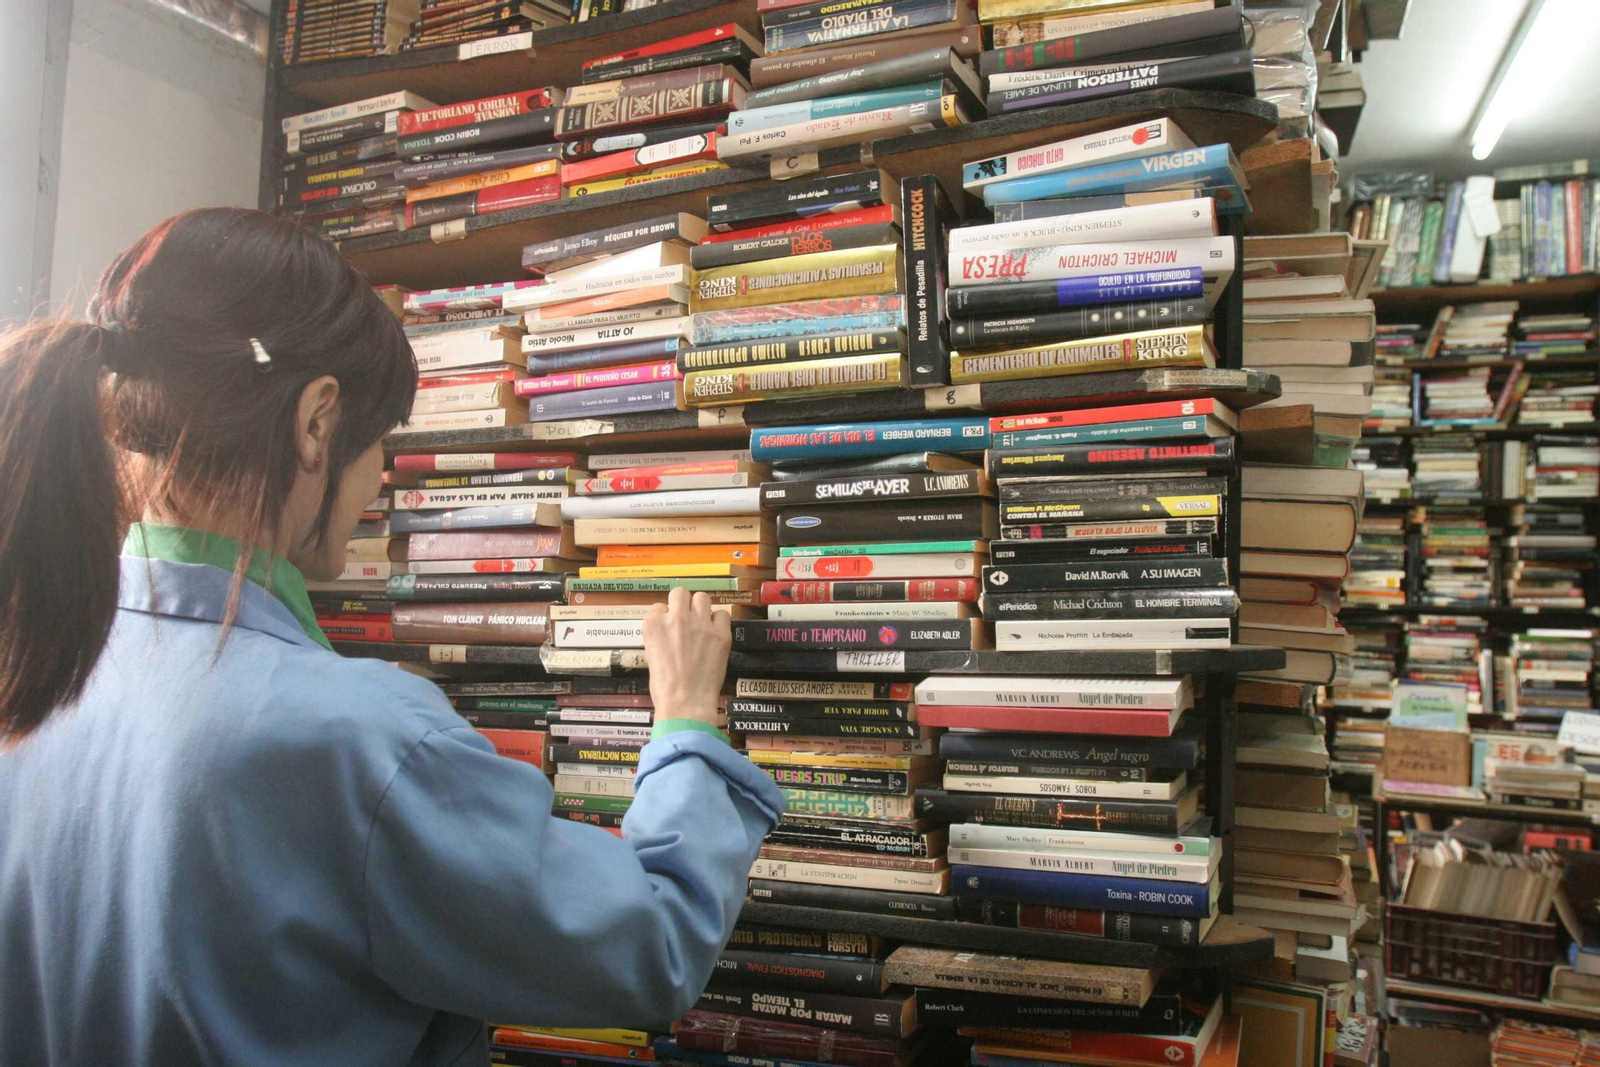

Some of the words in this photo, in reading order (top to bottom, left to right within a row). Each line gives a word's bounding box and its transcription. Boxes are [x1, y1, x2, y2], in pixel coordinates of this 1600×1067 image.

[821, 10, 869, 30] DIABLO
[871, 6, 893, 21] DEL
[892, 14, 909, 27] LA
[807, 17, 889, 43] ALTERNATIVA
[1077, 65, 1159, 89] PATTERSON
[1131, 76, 1158, 88] JAMES
[1028, 87, 1040, 96] DE
[1041, 80, 1072, 93] LUNA
[1003, 88, 1027, 99] MIEL
[415, 105, 476, 124] VICTORIANO
[478, 96, 520, 113] CORRAL
[434, 133, 455, 143] COOK
[456, 128, 481, 139] ROBIN
[404, 137, 431, 150] TOXINA
[1142, 149, 1208, 174] VIRGEN
[341, 181, 377, 195] CRUCIFAX
[910, 188, 926, 251] HITCHCOCK
[733, 241, 761, 252] ROBERT
[760, 237, 789, 248] CALDER
[800, 231, 824, 242] LOS
[1058, 252, 1119, 270] CRICHTON
[1122, 249, 1178, 267] MICHAEL
[961, 253, 1030, 280] PRESA
[699, 275, 738, 290] KING
[916, 260, 926, 297] Pesadilla
[1098, 274, 1123, 287] OCULTO
[1124, 273, 1134, 284] EN
[1135, 272, 1145, 282] LA
[1146, 268, 1191, 282] PROFUNDIDAD
[699, 284, 737, 300] STEPHEN
[918, 298, 927, 309] de
[623, 327, 634, 337] JO
[918, 310, 928, 342] Relatos
[597, 328, 622, 340] ATTIA
[1135, 332, 1188, 349] STEPHEN
[798, 338, 831, 356] COBEN
[834, 333, 873, 353] HARLAN
[684, 345, 748, 368] OPORTUNIDAD
[751, 342, 787, 360] ÚLTIMA
[1136, 345, 1188, 360] KING
[962, 350, 1038, 374] CEMENTERIO
[1039, 349, 1054, 366] DE
[1055, 343, 1121, 365] ANIMALES
[818, 367, 830, 385] DE
[832, 363, 874, 384] RETRATO
[874, 361, 887, 380] EL
[694, 373, 735, 386] KING
[750, 370, 789, 391] MADDER
[791, 368, 816, 388] ROSE
[694, 382, 734, 397] STEPHEN
[829, 431, 843, 444] DE
[844, 430, 861, 443] DIA
[863, 429, 876, 442] EL
[882, 429, 915, 440] WERBER
[915, 427, 952, 439] BERNARD
[963, 426, 984, 437] P&J
[759, 433, 810, 448] HORMIGAS
[810, 433, 828, 446] LAS
[1087, 447, 1145, 463] ASESINO
[1148, 444, 1216, 460] INSTINTO
[815, 481, 864, 499] SEMILLAS
[863, 480, 875, 490] DEL
[873, 478, 910, 496] AYER
[429, 495, 457, 503] AGUAS
[458, 494, 475, 502] LAS
[490, 493, 506, 501] PAN
[510, 492, 535, 500] SHAW
[536, 491, 563, 500] IRWIN
[1178, 501, 1208, 510] VERSAL
[1006, 511, 1038, 520] CONTRA
[1038, 511, 1049, 519] EL
[1049, 509, 1084, 519] MAÑANA
[1074, 526, 1103, 537] MUERTA
[1104, 526, 1123, 535] BAJO
[1124, 525, 1134, 534] LA
[1135, 524, 1159, 534] LLUVIA
[362, 567, 378, 576] RUSH
[573, 582, 602, 591] BRIGADA
[603, 582, 617, 591] DEL
[616, 582, 634, 591] VICIO
[1053, 600, 1085, 610] Michael
[1086, 599, 1123, 609] Crichton
[1135, 599, 1144, 608] EL
[1146, 599, 1181, 608] HOMBRE
[1182, 597, 1223, 608] TERMINAL
[443, 614, 458, 624] TOM
[458, 614, 484, 624] CLANCY
[487, 612, 515, 625] PÁNICO
[515, 615, 547, 625] NUCLEAR
[892, 610, 909, 618] Mary
[923, 610, 948, 618] Shelley
[586, 628, 634, 637] interminable
[765, 627, 798, 642] TARDE
[809, 628, 867, 643] TEMPRANO
[910, 630, 941, 640] ELIZABETH
[941, 630, 961, 640] ADLER
[1065, 631, 1089, 639] Proffitt
[1101, 632, 1134, 640] Embajada
[844, 651, 902, 666] THRILLER
[995, 693, 1027, 703] MARVIN
[1031, 693, 1061, 704] ALBERT
[1103, 694, 1114, 704] de
[1114, 693, 1144, 705] Piedra
[732, 702, 778, 714] HITCHCOCK
[777, 702, 785, 713] A.
[824, 706, 839, 714] VER
[840, 707, 861, 715] PARA
[862, 707, 889, 716] MORIR
[734, 721, 781, 732] HITCHCOCK
[780, 722, 790, 732] A.
[840, 725, 860, 733] VIVA
[860, 725, 893, 734] SANGRE
[893, 725, 901, 734] A
[578, 749, 620, 760] NOCTURNAS
[776, 769, 813, 784] VEGAS
[813, 770, 847, 785] STRIP
[1039, 783, 1071, 793] FAMOSOS
[1075, 784, 1097, 794] ROBOS
[841, 832, 853, 842] EL
[854, 833, 910, 846] ATRACADOR
[1029, 856, 1062, 868] MARVIN
[1064, 859, 1094, 871] ALBERT
[1136, 862, 1147, 874] de
[1147, 863, 1178, 876] Piedra
[1106, 888, 1133, 901] Toxina
[1139, 891, 1166, 904] ROBIN
[1167, 893, 1194, 906] COOK
[827, 941, 868, 954] FORSYTH
[752, 993, 791, 1007] TIEMPO
[793, 999, 805, 1008] EL
[752, 1002, 787, 1016] MATAR
[790, 1007, 813, 1019] POR
[924, 1003, 946, 1011] Robert
[946, 1004, 965, 1012] Clark
[815, 1009, 852, 1025] MATAR
